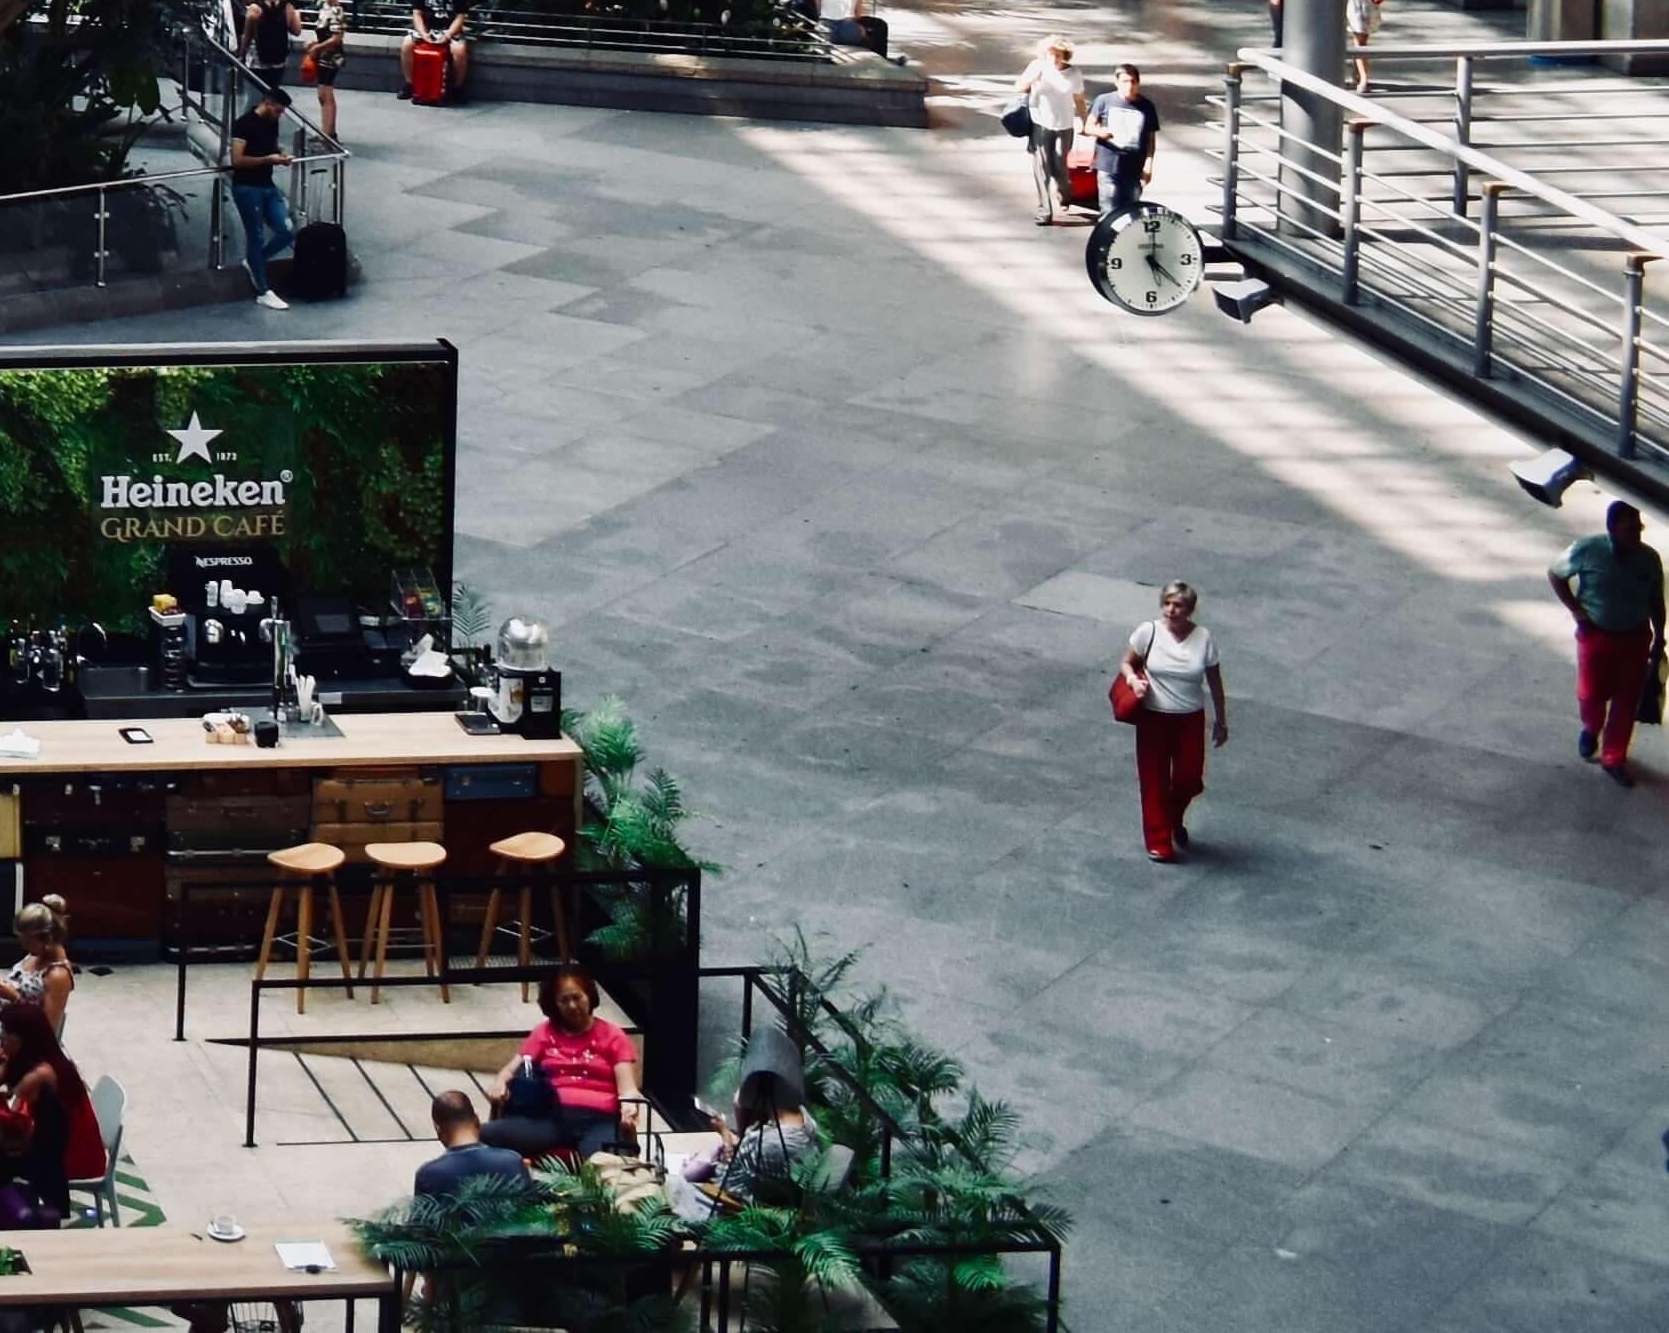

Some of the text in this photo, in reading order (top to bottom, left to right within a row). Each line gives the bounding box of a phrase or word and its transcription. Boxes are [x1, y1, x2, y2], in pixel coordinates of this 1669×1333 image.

[1143, 221, 1161, 233] 12
[1111, 258, 1122, 270] 9
[1180, 253, 1191, 266] 3
[1146, 290, 1158, 303] 6
[152, 452, 173, 463] EST.
[101, 473, 286, 508] Heineken
[101, 510, 286, 544] GRAND CAFÉ
[195, 555, 254, 568] NESPRESSO
